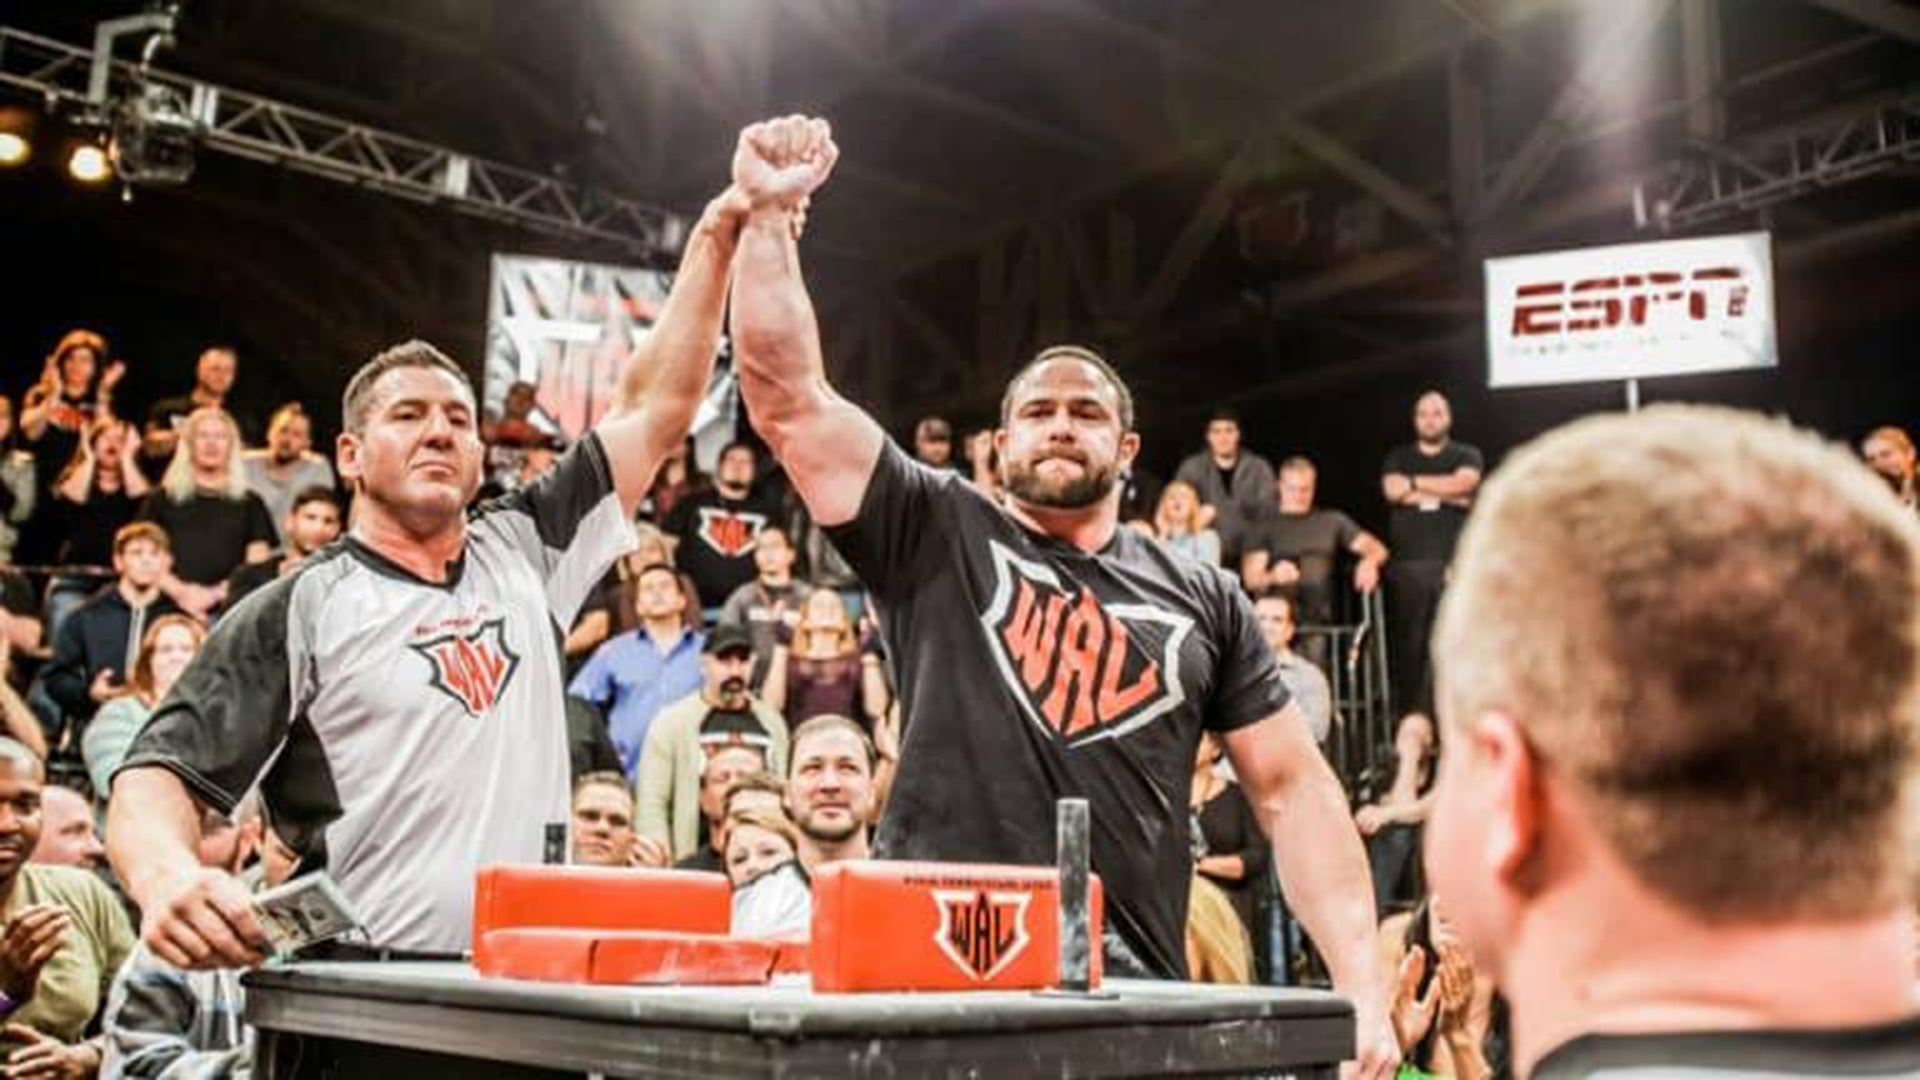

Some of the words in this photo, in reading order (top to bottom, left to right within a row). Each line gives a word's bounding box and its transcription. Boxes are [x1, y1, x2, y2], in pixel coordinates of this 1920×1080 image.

[1512, 266, 1746, 337] ESPN
[437, 637, 505, 711] WAL
[1003, 576, 1159, 737] WAL
[949, 891, 1016, 974] WAL
